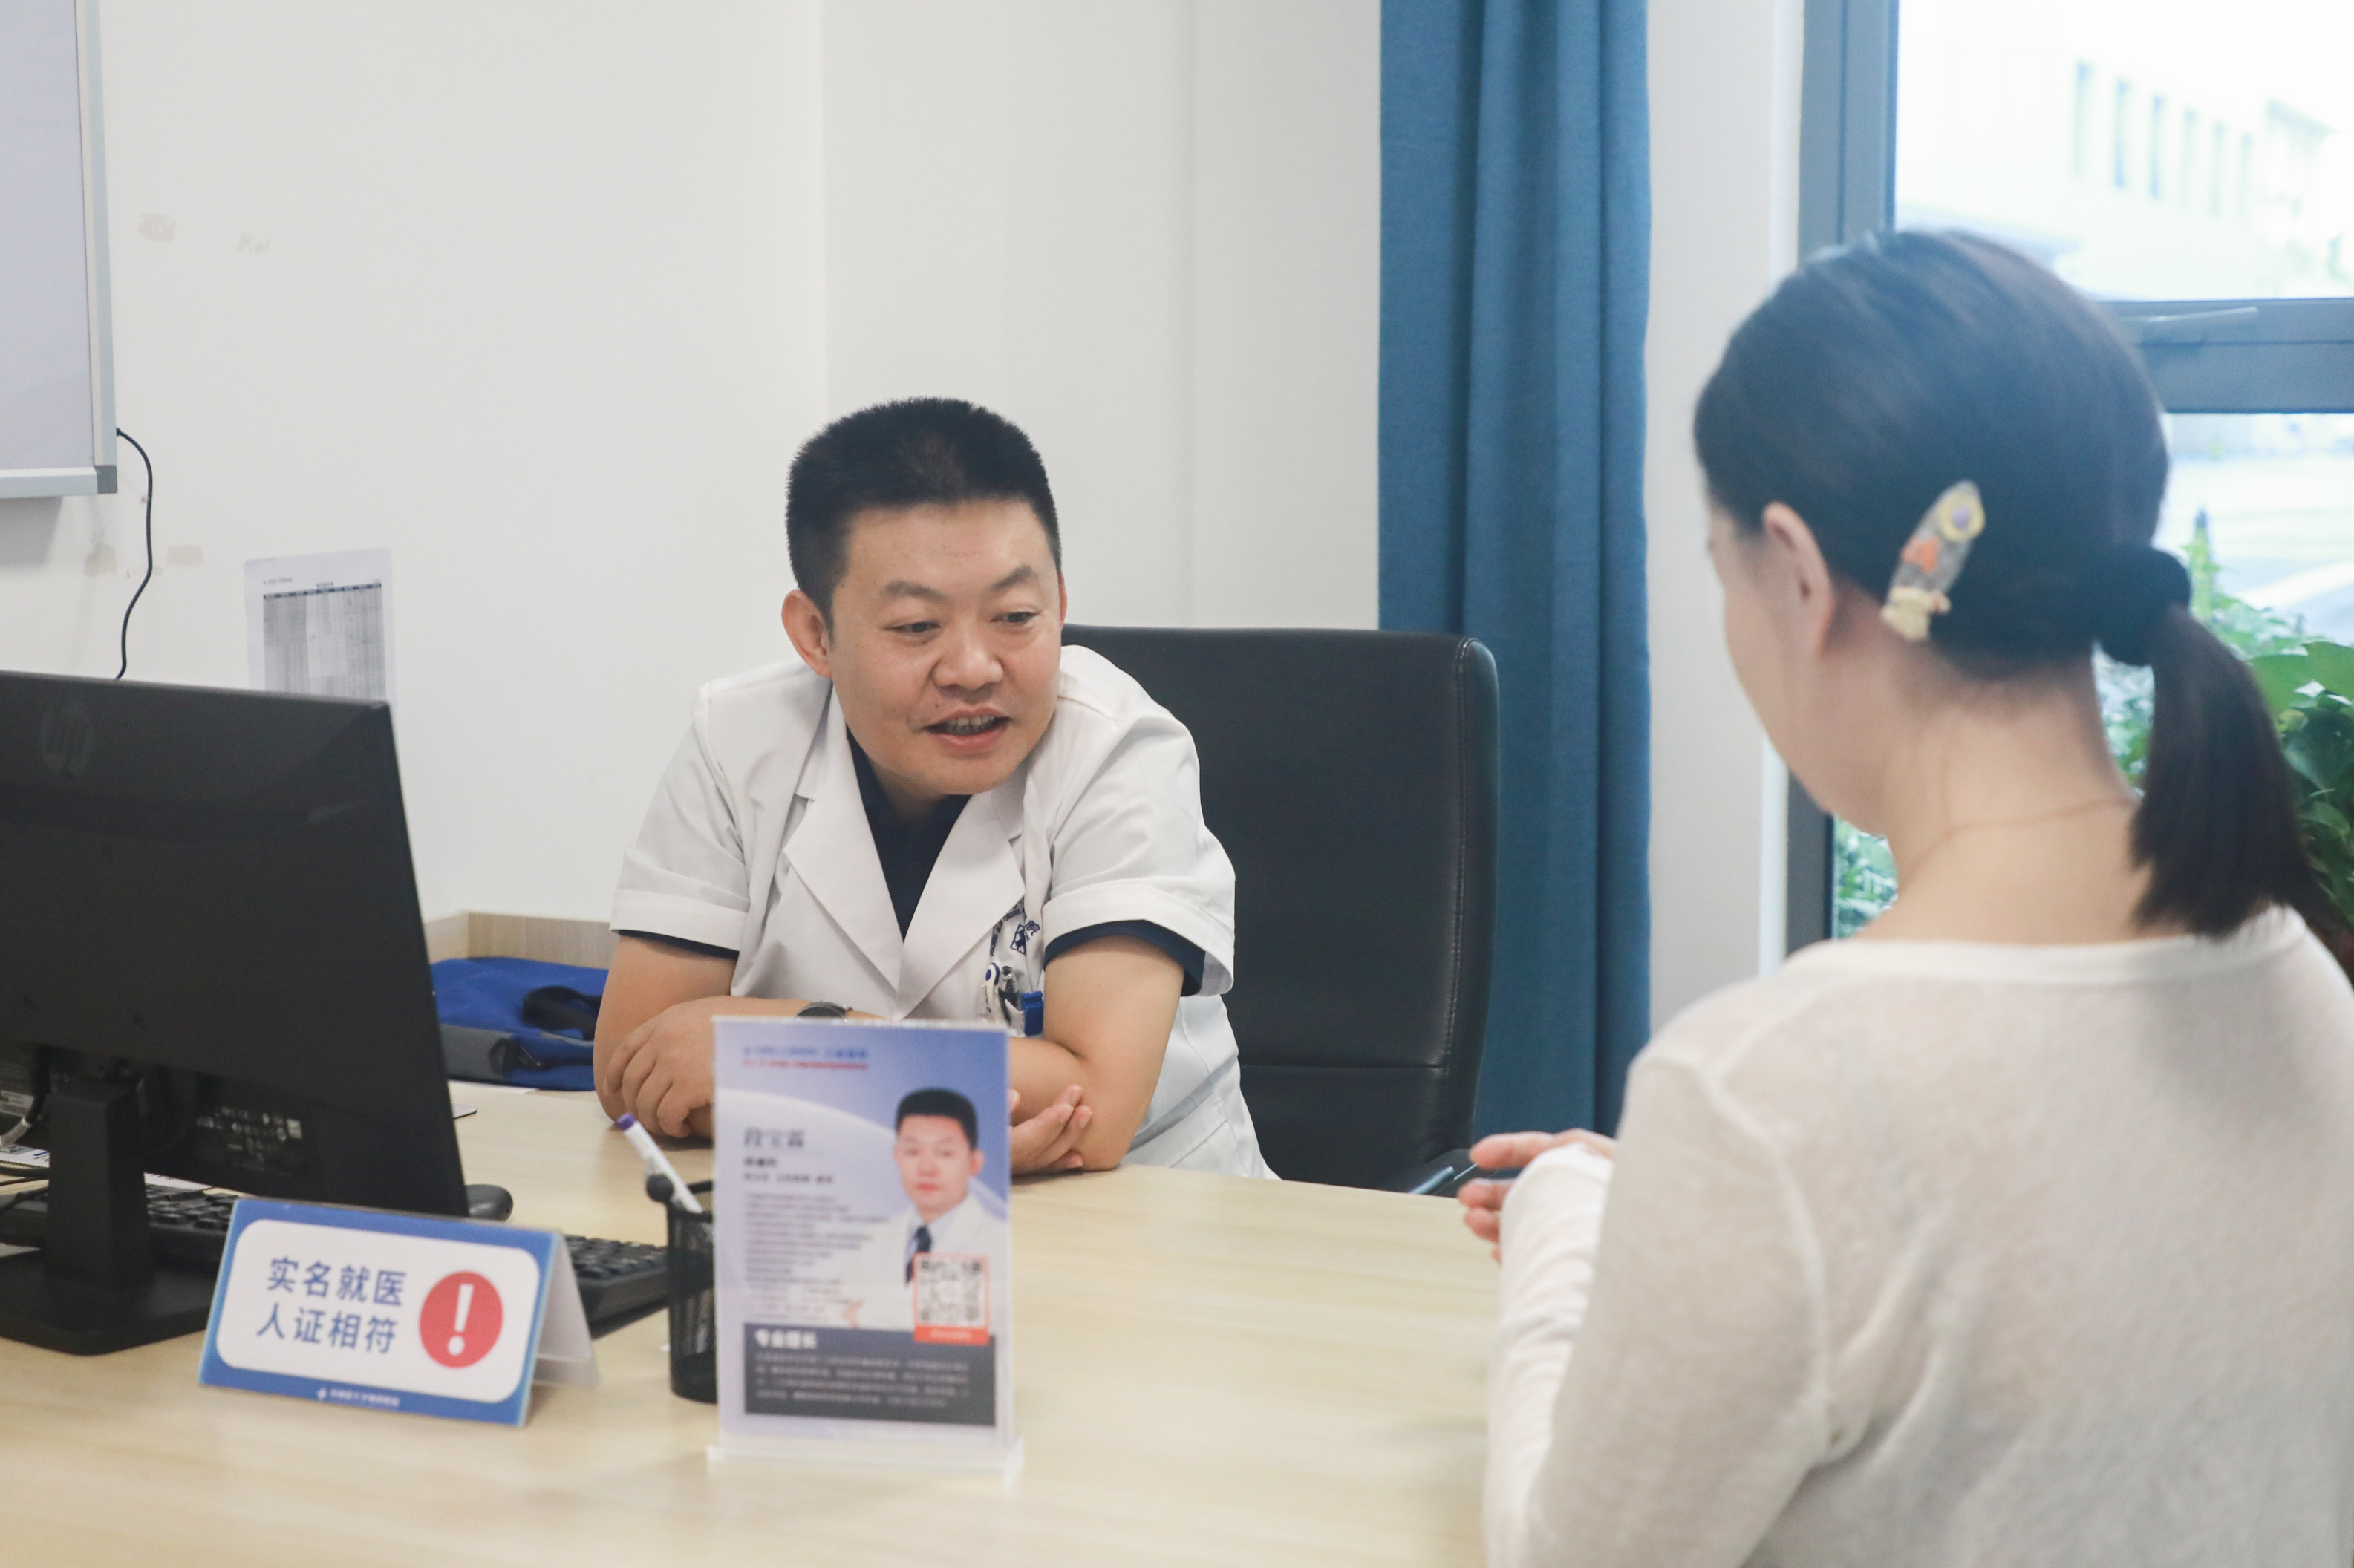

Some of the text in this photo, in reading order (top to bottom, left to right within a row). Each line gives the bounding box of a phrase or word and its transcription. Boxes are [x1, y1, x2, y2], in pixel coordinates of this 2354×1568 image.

[267, 1256, 407, 1307] 实名就医
[256, 1302, 398, 1354] 人证相符
